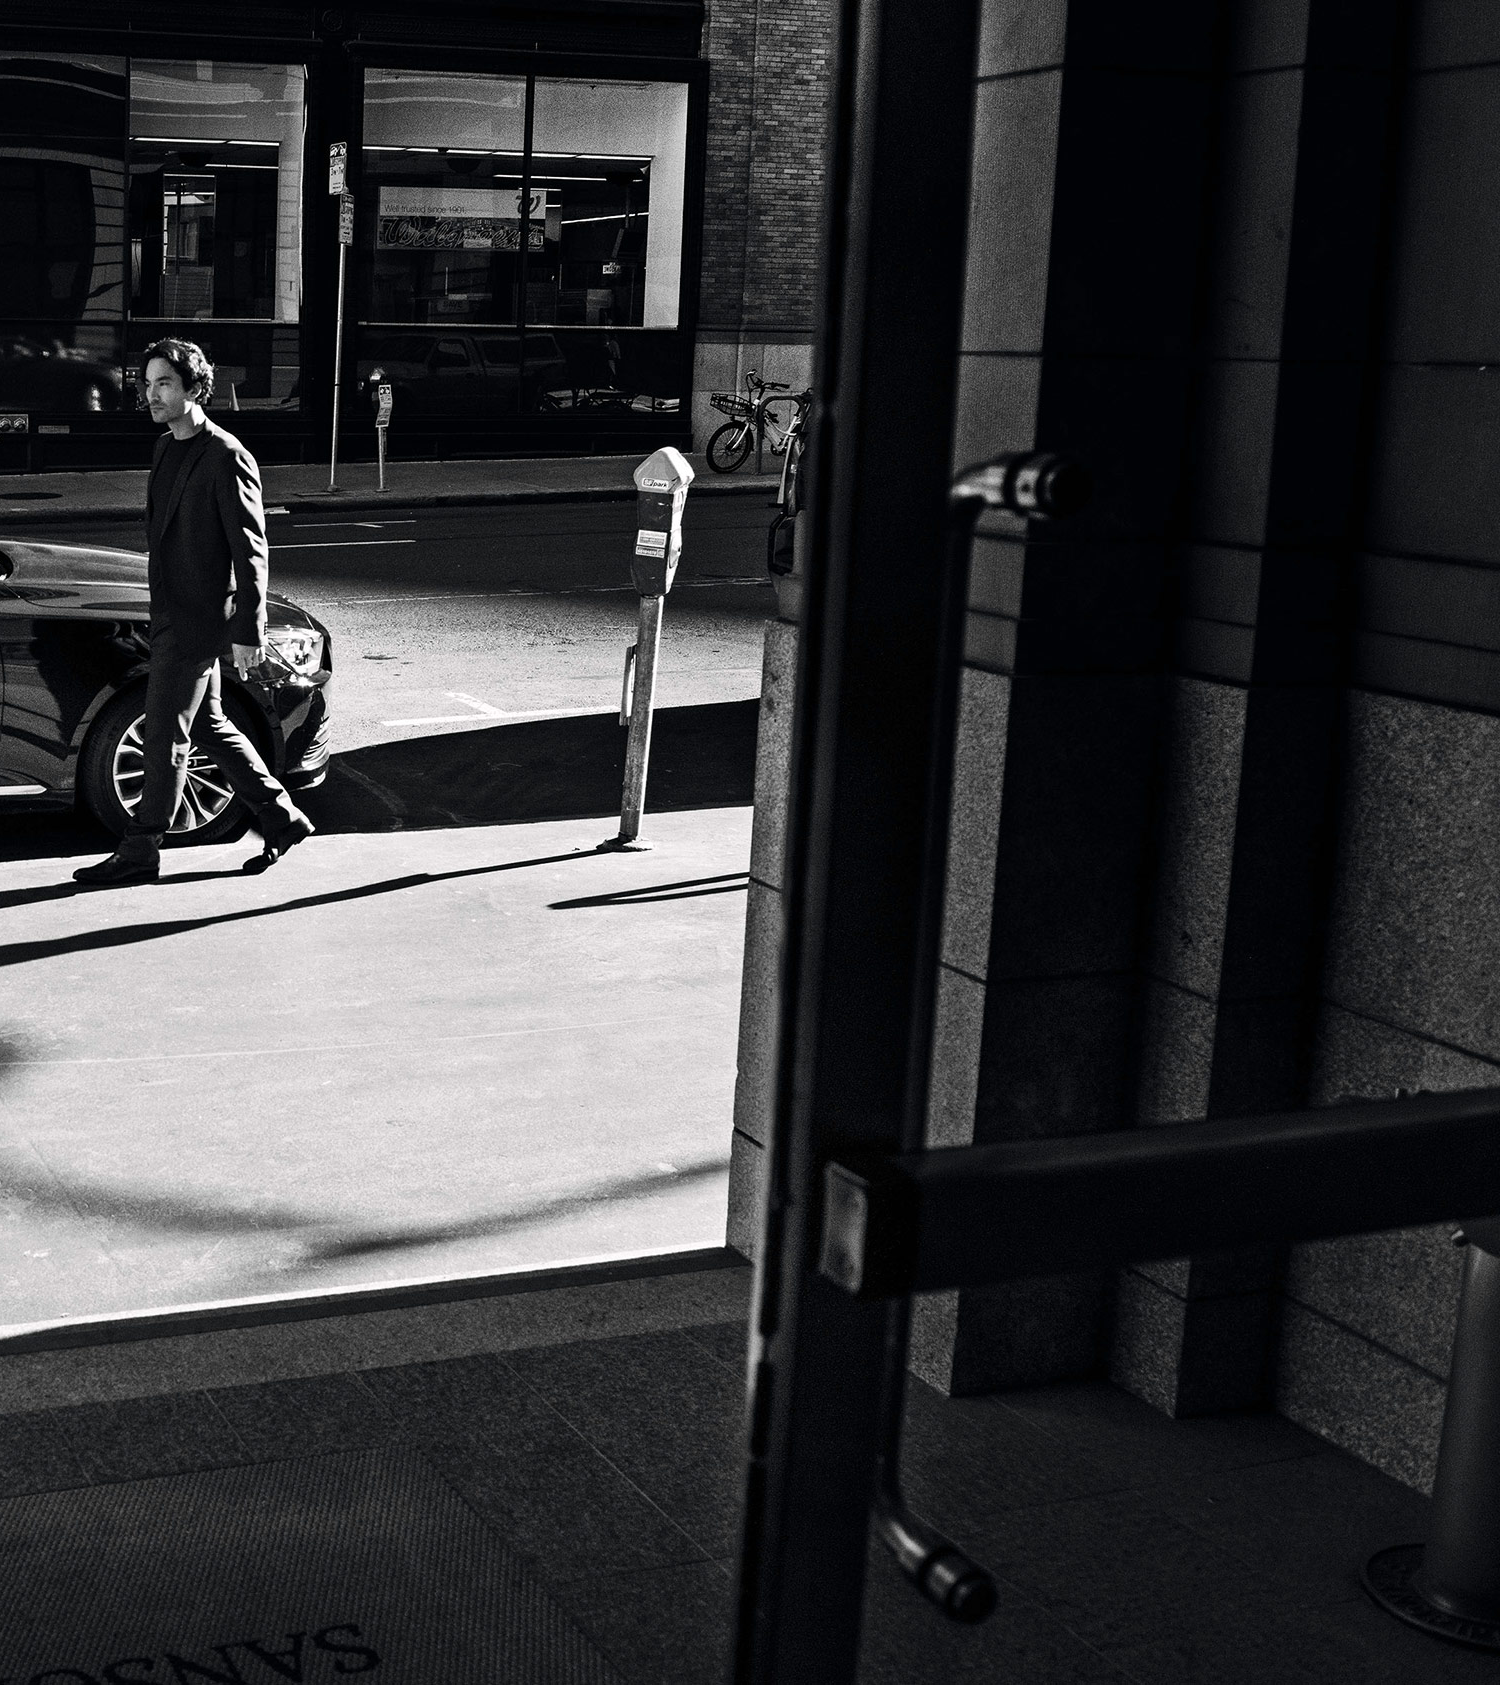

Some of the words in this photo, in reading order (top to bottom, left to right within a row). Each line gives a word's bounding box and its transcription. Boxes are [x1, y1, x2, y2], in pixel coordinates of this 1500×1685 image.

[384, 204, 399, 213] Well
[401, 205, 426, 213] trusted
[427, 205, 446, 214] since
